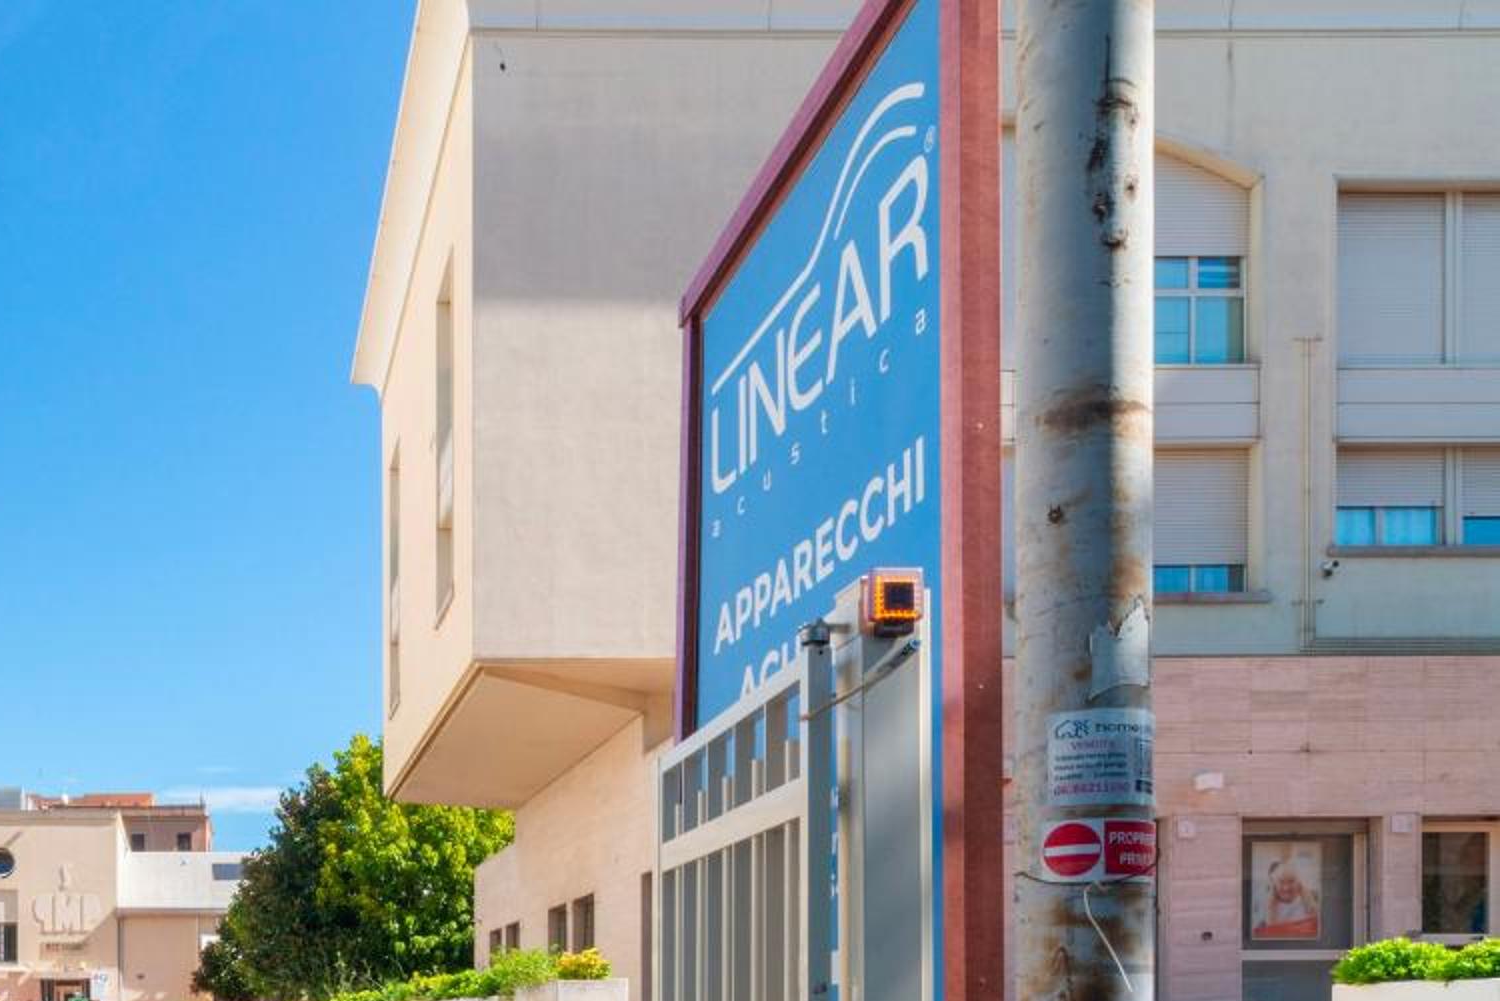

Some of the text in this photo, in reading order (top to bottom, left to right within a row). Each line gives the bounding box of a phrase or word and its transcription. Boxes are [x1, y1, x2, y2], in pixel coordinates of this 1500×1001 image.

[711, 154, 929, 495] LINEAR
[711, 307, 927, 539] acustica
[713, 435, 926, 656] APPARECCHI
